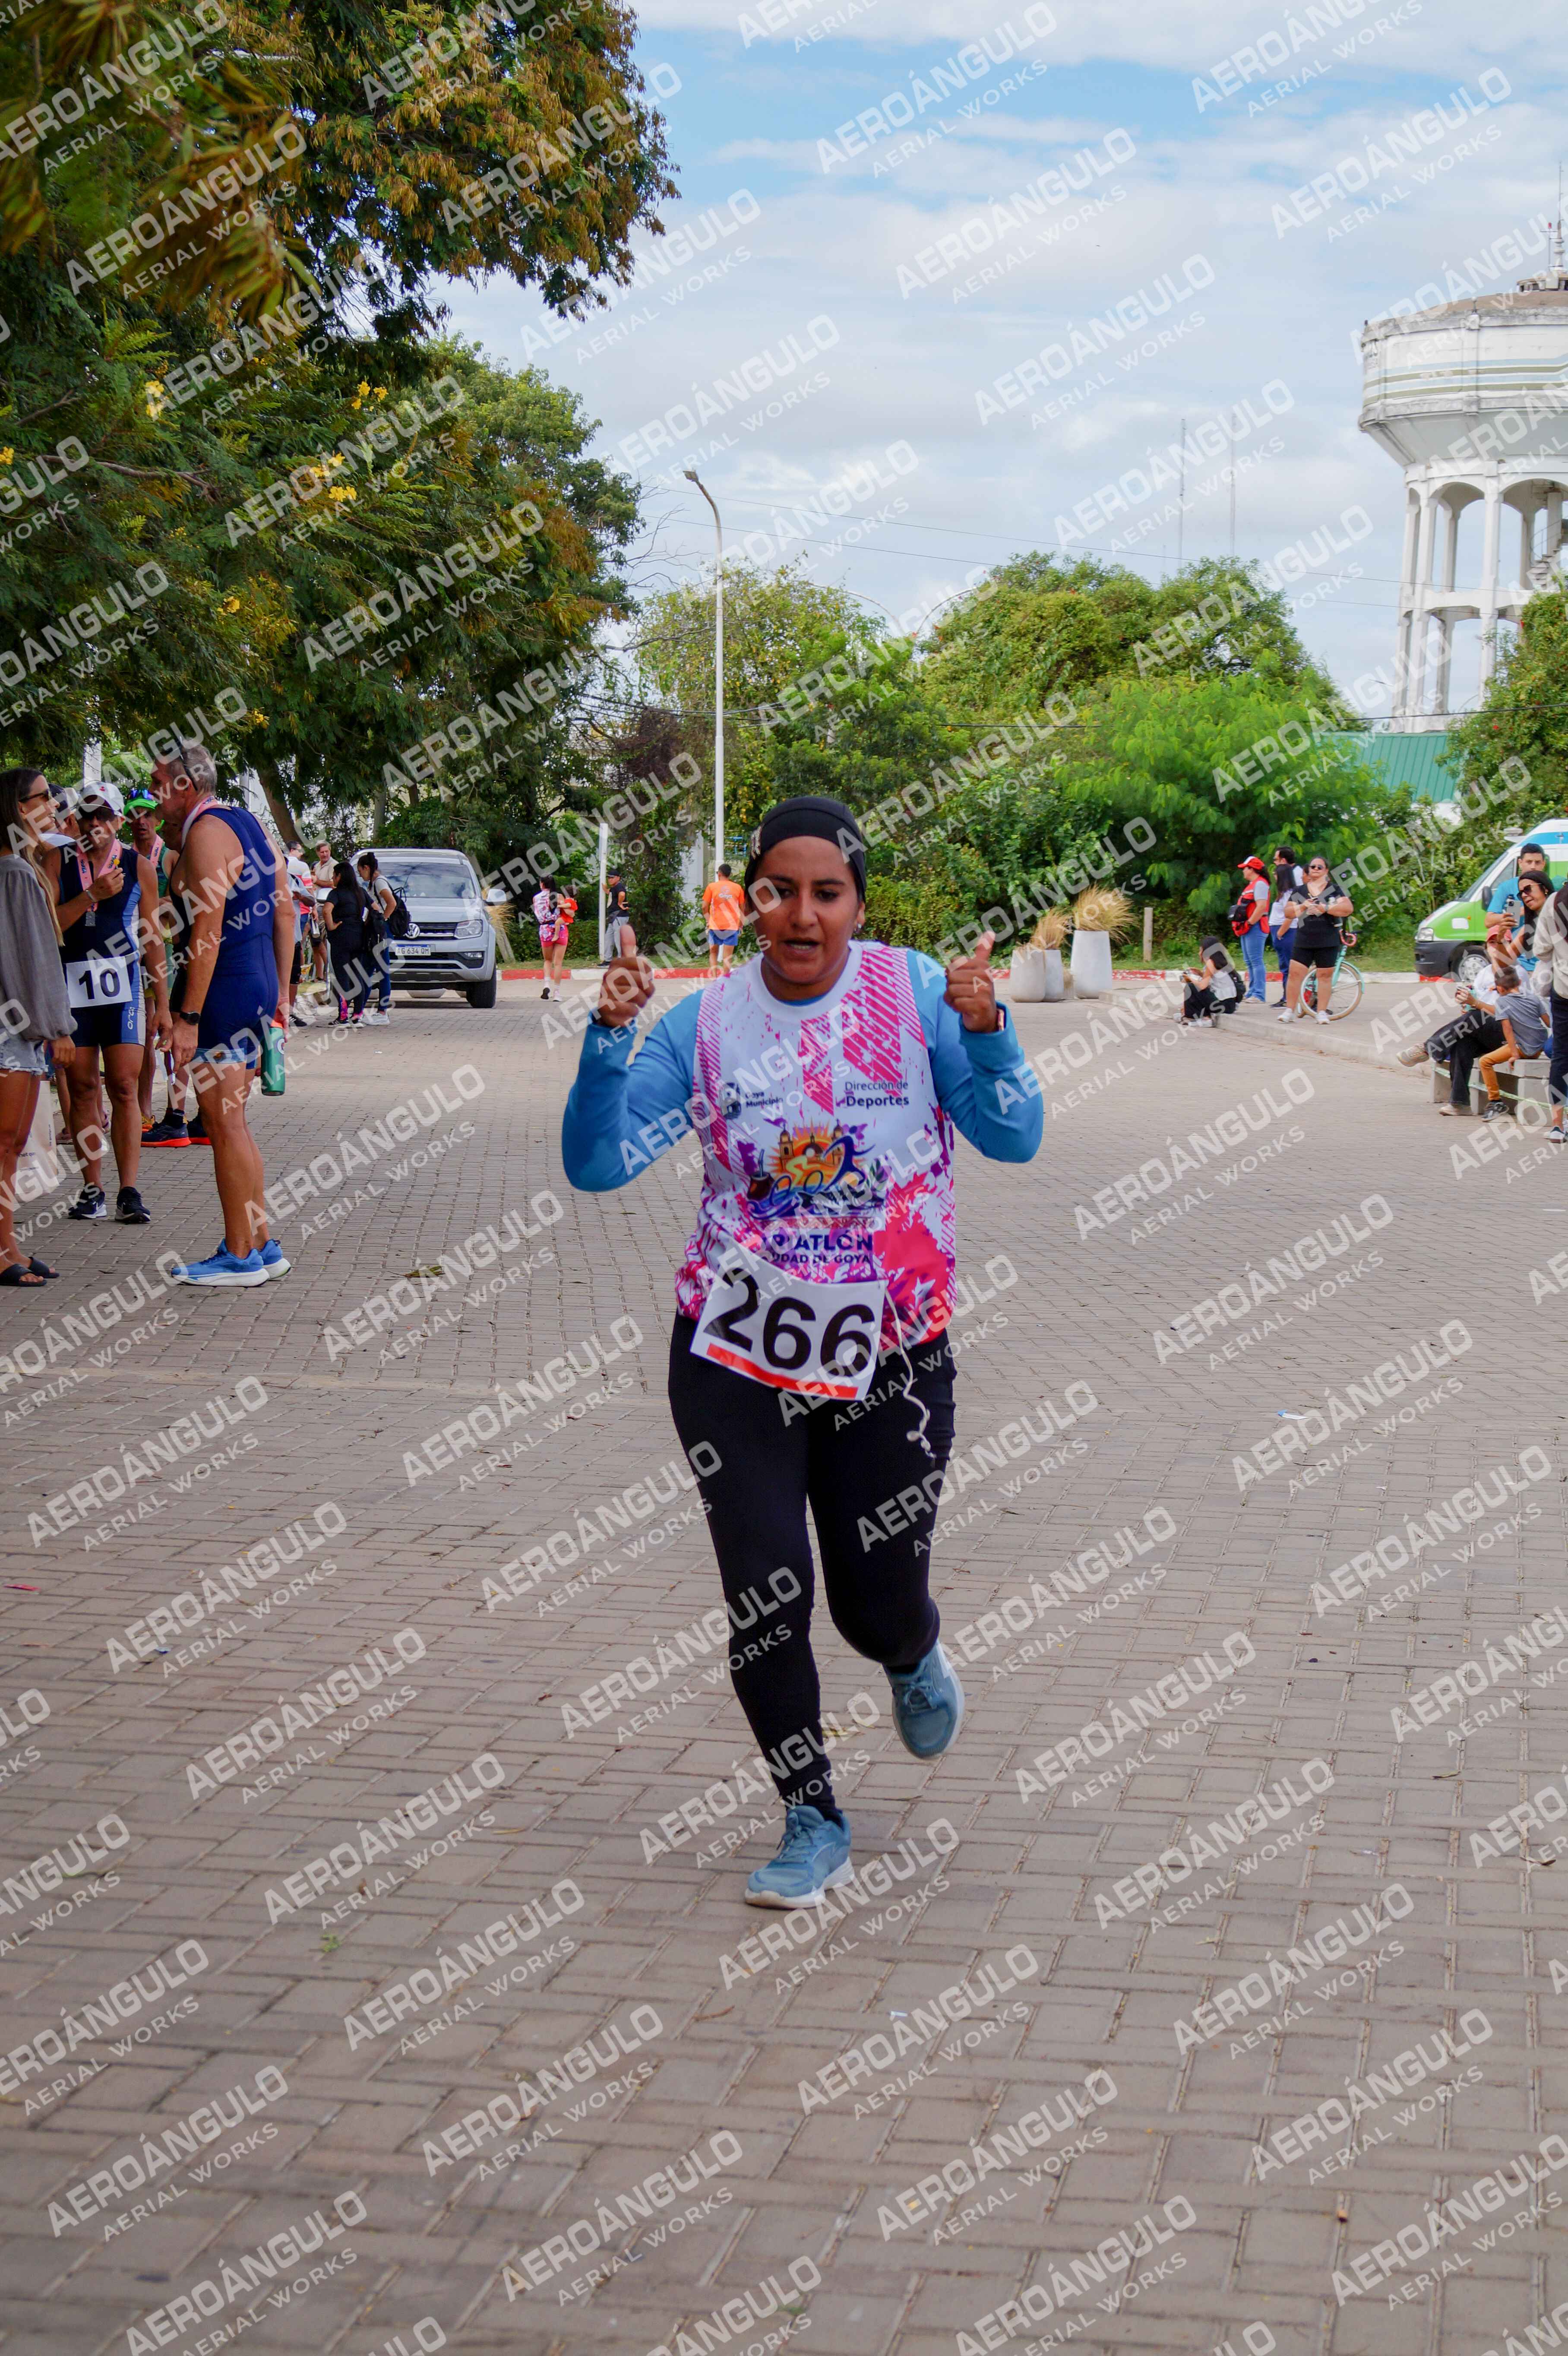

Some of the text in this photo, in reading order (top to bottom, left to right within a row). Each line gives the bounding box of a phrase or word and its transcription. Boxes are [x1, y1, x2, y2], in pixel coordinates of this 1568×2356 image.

[79, 968, 120, 1000] 10
[845, 1080, 908, 1091] Dirección de
[846, 1096, 910, 1109] Deportes
[835, 1254, 870, 1264] GOYA
[703, 1265, 876, 1377] 266
